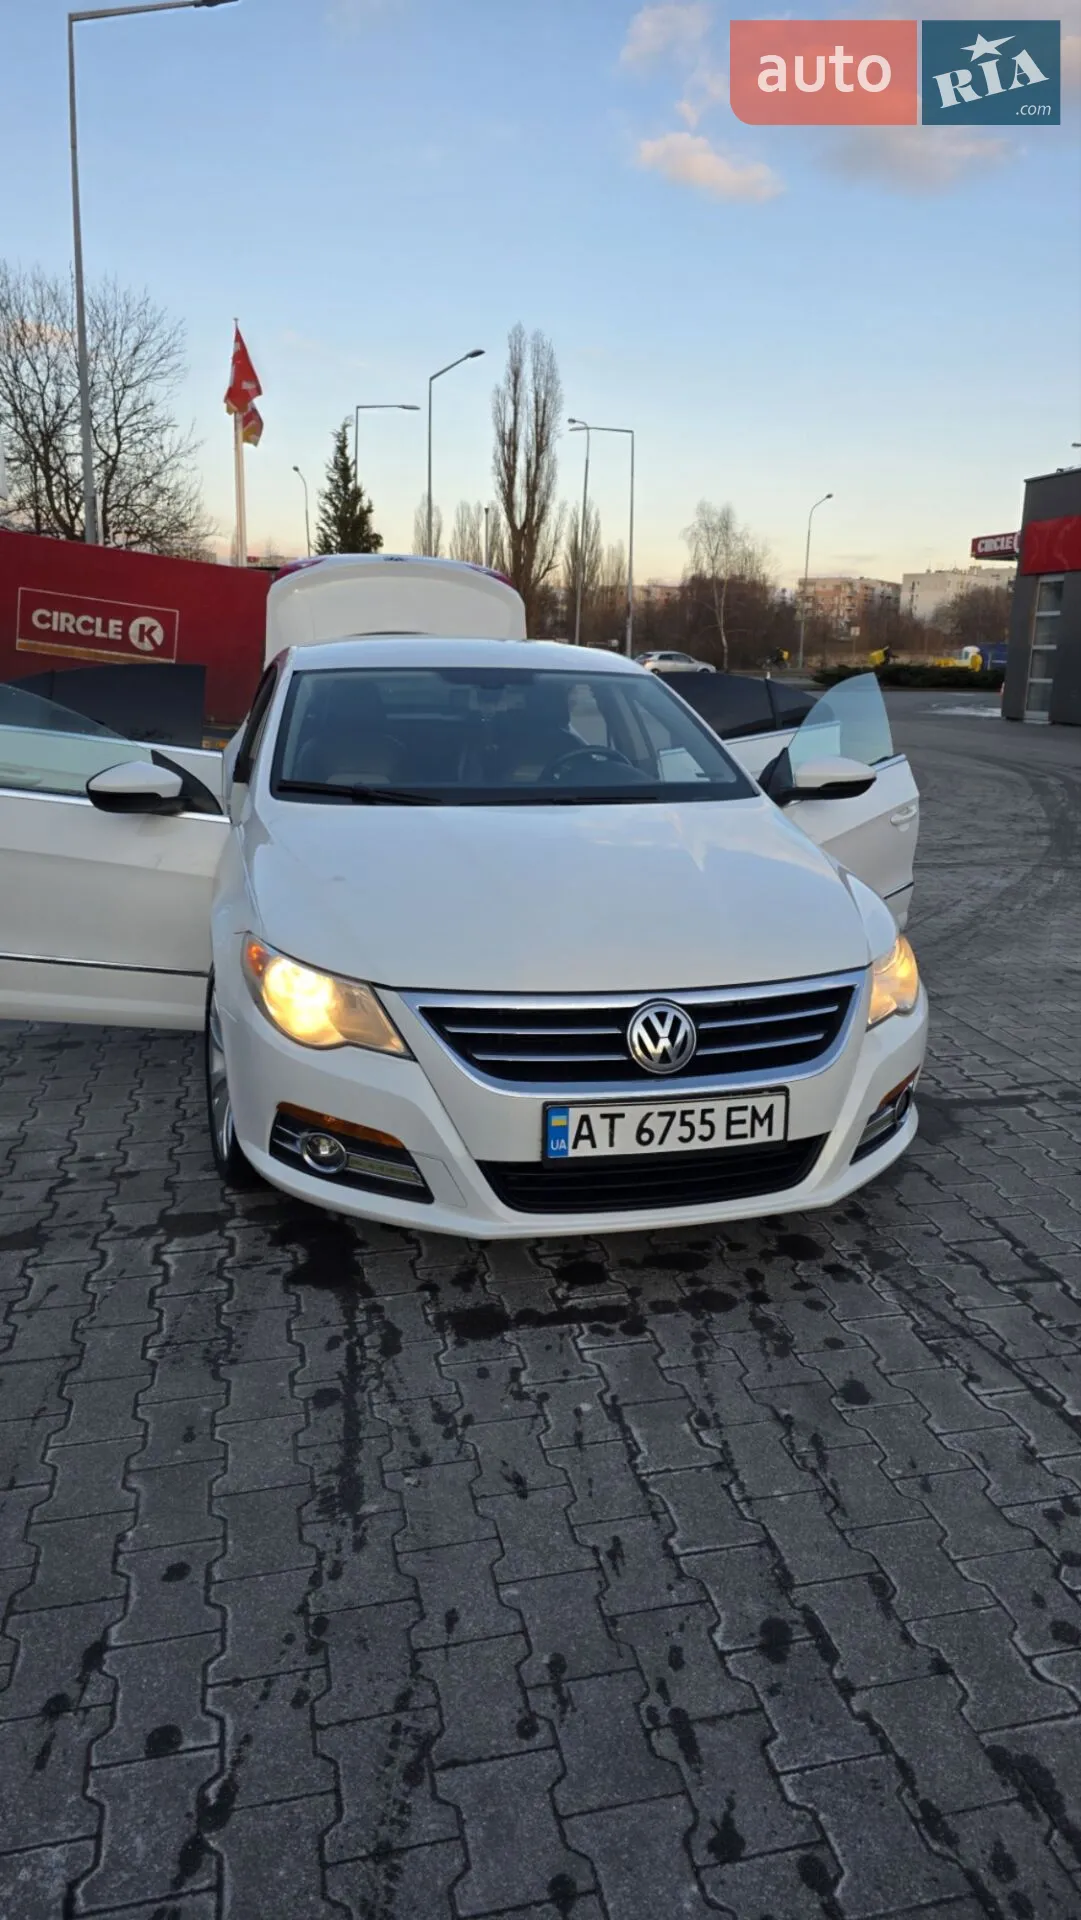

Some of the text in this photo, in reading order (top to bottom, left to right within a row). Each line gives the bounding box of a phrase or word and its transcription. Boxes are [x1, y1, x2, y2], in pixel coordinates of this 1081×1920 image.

[31, 608, 163, 651] CIRCLE K
[550, 1138, 568, 1151] UA
[571, 1102, 775, 1150] AT 6755 EM
